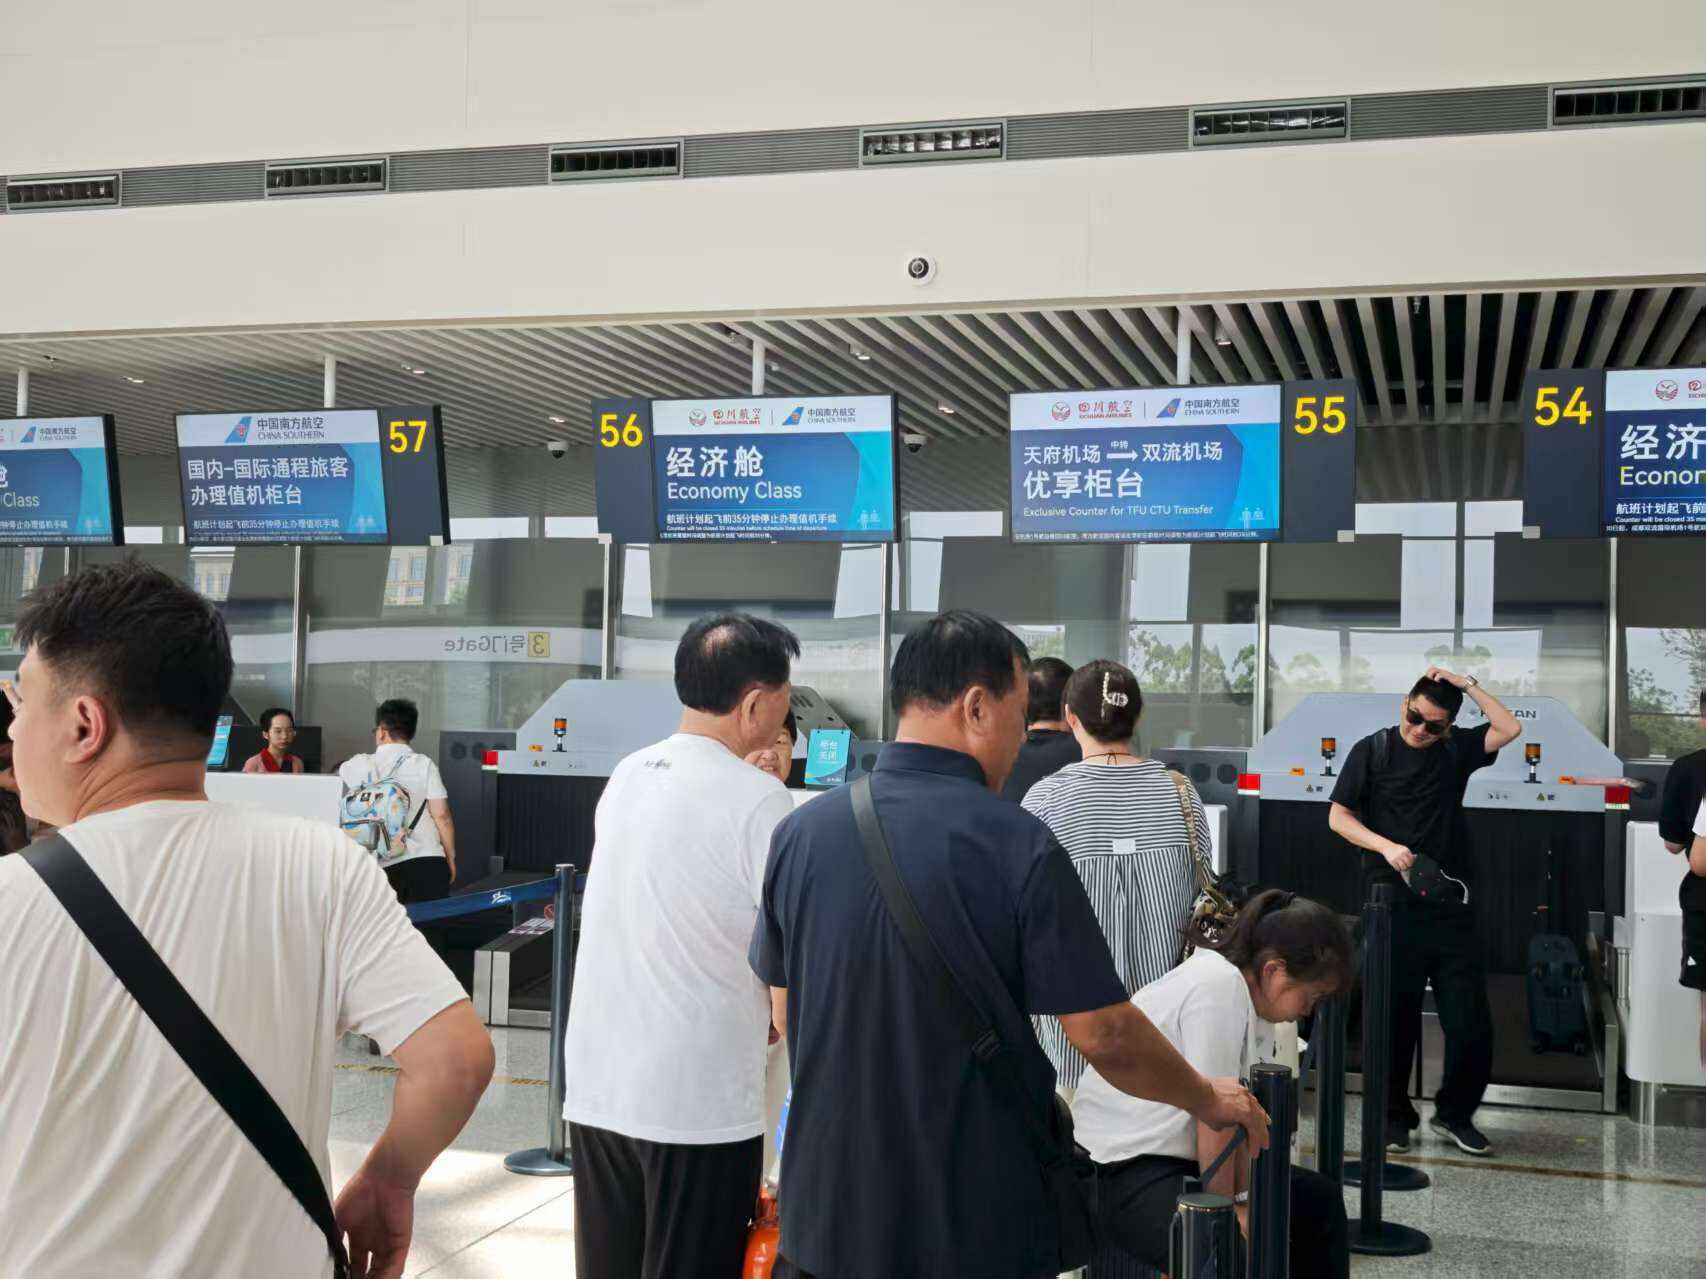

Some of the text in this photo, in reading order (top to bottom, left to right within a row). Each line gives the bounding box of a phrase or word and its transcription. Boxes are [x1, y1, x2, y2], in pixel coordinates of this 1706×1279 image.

[807, 407, 856, 417] 中国南方航空
[1184, 398, 1240, 408] 中国南方航空
[1535, 386, 1592, 426] 54
[257, 416, 324, 430] 中国南方航空
[1294, 396, 1346, 435] 55
[257, 431, 283, 440] CHINA
[389, 420, 427, 453] 57
[600, 413, 643, 448] 56
[666, 445, 764, 478] 经济舱
[1023, 445, 1101, 465] 天府机场
[1142, 441, 1223, 462] 双流机场
[668, 481, 802, 504] Economy Class
[1023, 468, 1144, 499] 优享柜台
[3, 492, 40, 508] Class
[191, 485, 302, 506] 办理值机柜台
[1023, 504, 1214, 517] Exclusive Counter for TFU CTU Transfer
